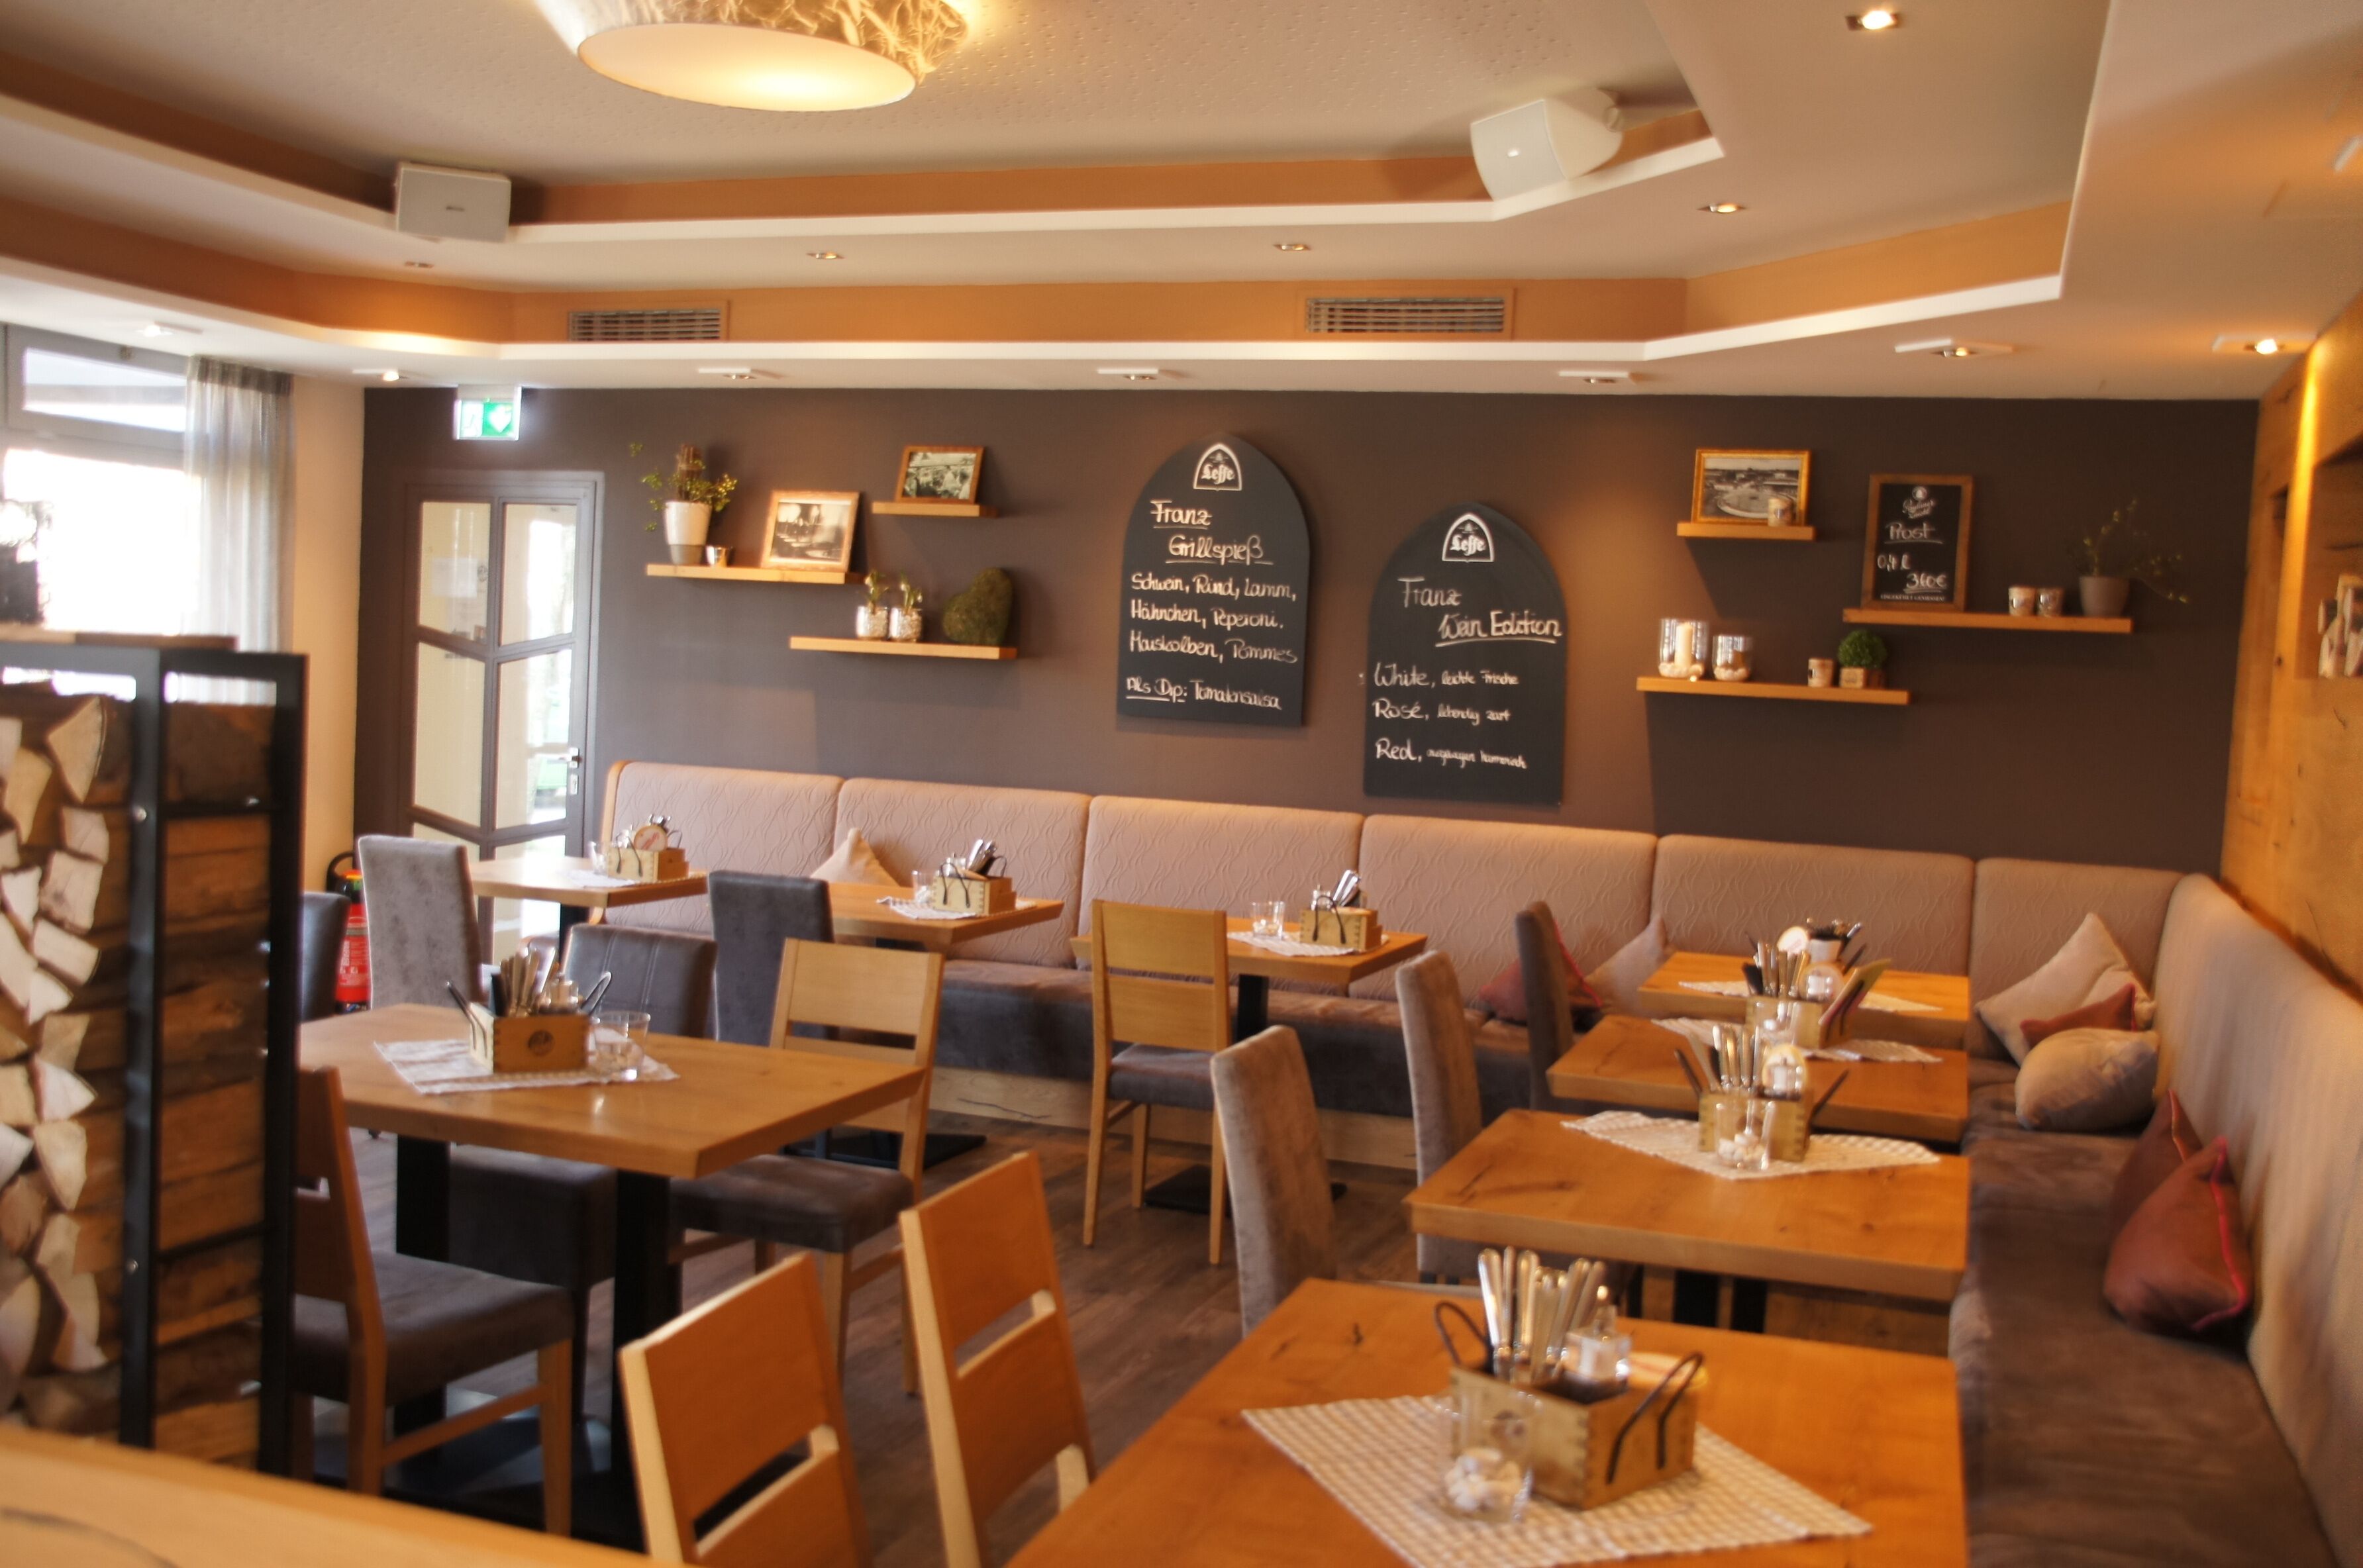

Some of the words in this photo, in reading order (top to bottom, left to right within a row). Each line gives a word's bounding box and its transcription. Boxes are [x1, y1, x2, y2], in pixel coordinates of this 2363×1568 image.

[1201, 464, 1235, 485] Leffe
[1150, 499, 1213, 526] Franz
[1885, 522, 1936, 540] Prost
[1168, 534, 1264, 565] Grillspieß
[1450, 534, 1486, 556] Leffe
[1131, 571, 1190, 594] Schwein,
[1193, 573, 1240, 600] Rind,
[1244, 577, 1296, 601] Lamm,
[1397, 577, 1462, 608] Franz
[1131, 599, 1207, 629] Hähnchen,
[1438, 613, 1487, 640] Wein
[1490, 610, 1562, 637] Edition
[1130, 630, 1224, 663] Maiskolben,
[1225, 638, 1298, 663] Pommes
[1374, 662, 1435, 688] White,
[1126, 676, 1152, 694] Als
[1154, 677, 1187, 703] Dip:
[1372, 697, 1429, 721] Rosé,
[1376, 737, 1422, 762] Red,
